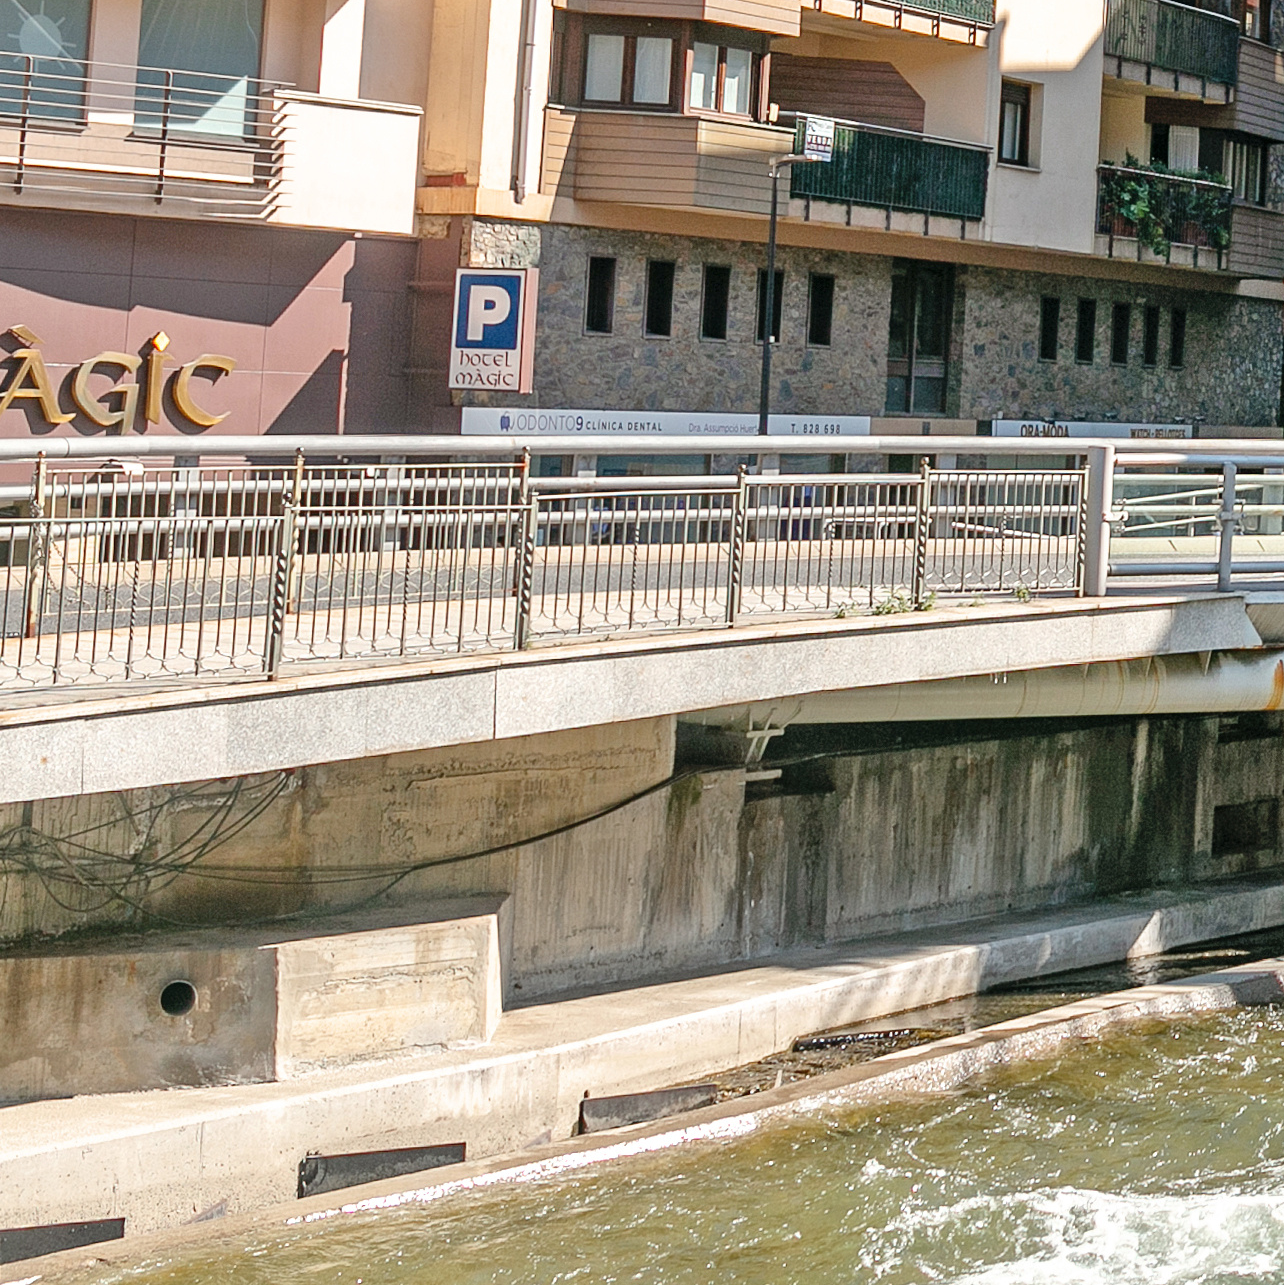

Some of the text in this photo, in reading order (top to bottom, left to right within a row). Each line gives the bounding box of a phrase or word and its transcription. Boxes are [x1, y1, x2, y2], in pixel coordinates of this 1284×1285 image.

[466, 284, 511, 341] P
[585, 416, 624, 431] CLÍNICA
[627, 420, 663, 432] DENTAL
[803, 424, 820, 434] 828
[824, 424, 841, 435] 698
